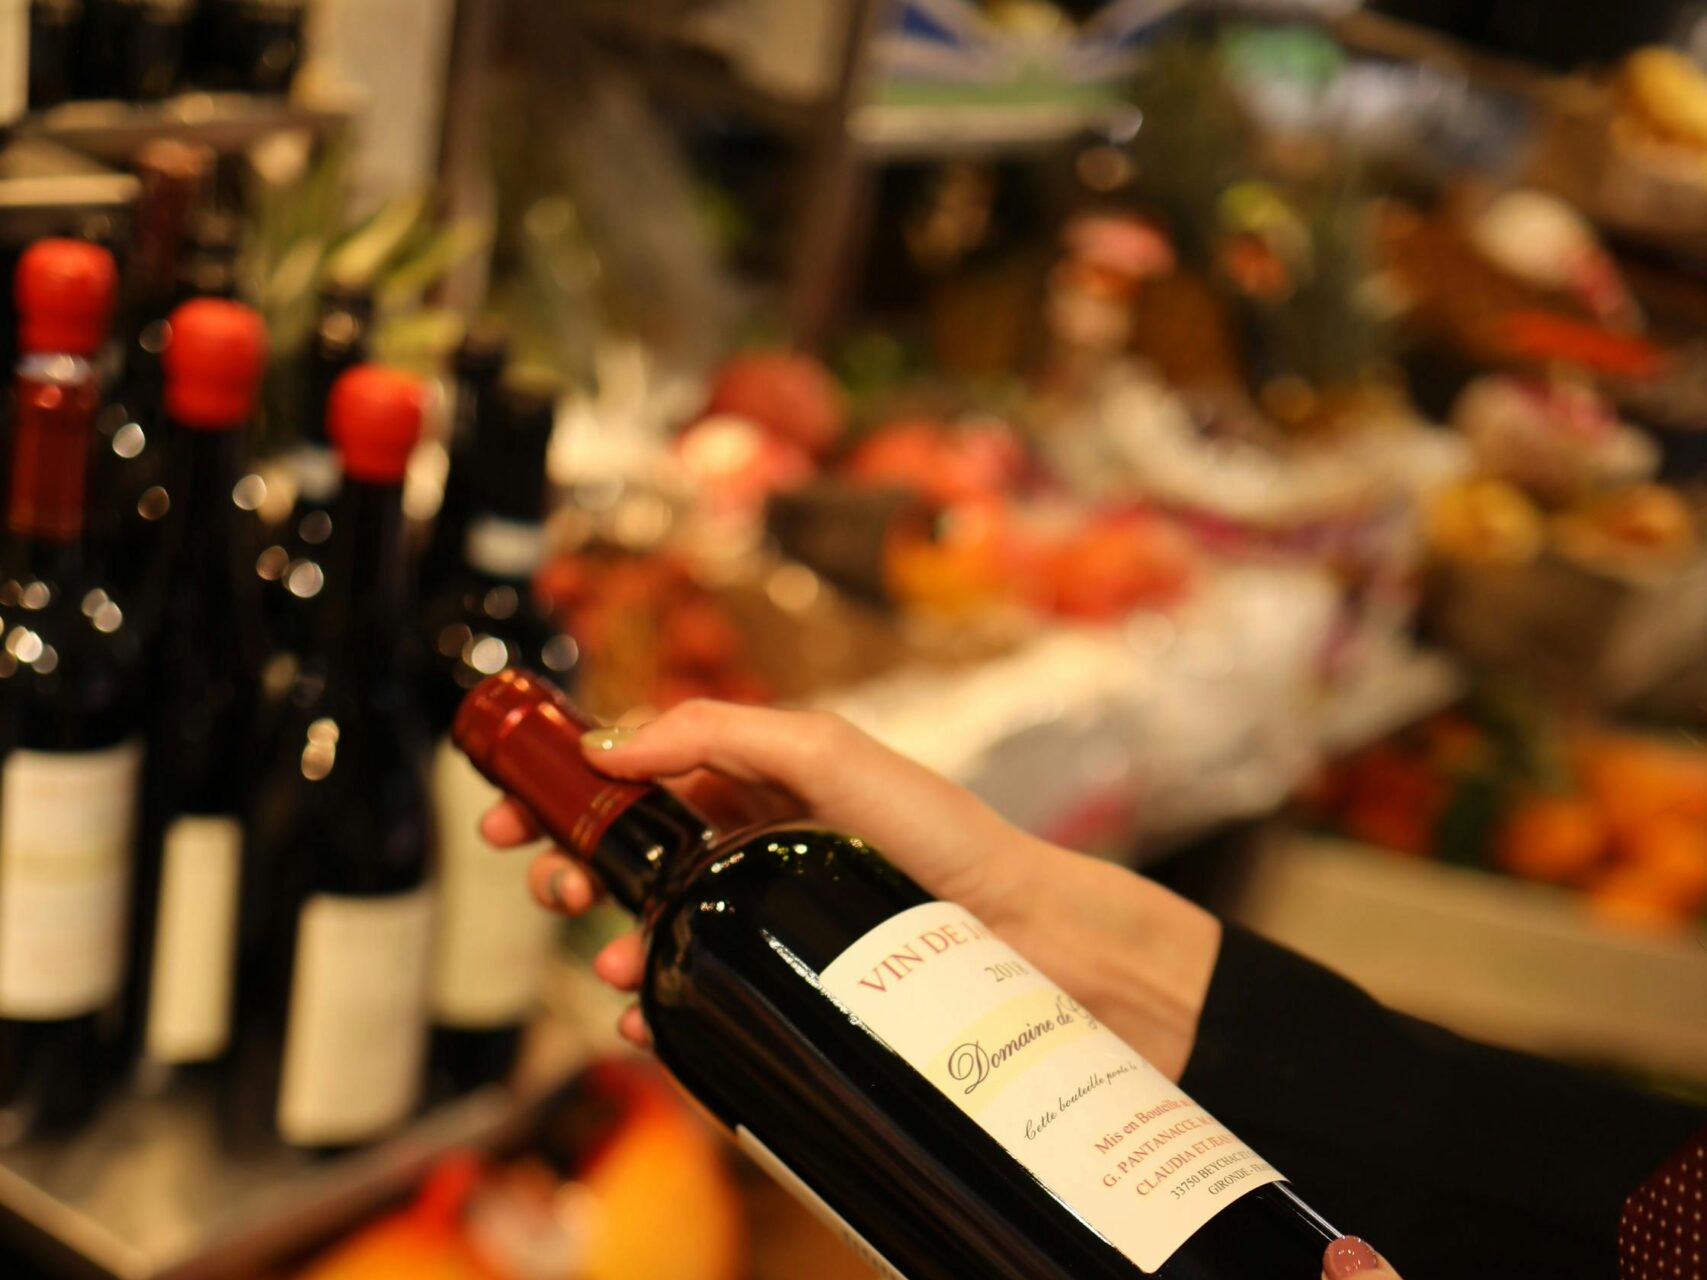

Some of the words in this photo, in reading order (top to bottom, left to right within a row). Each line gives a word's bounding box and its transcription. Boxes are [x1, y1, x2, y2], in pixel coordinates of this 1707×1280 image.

[857, 944, 925, 993] VIN
[919, 923, 969, 954] DE
[947, 1019, 1055, 1095] Domaine
[1056, 995, 1075, 1026] de
[1024, 1111, 1057, 1140] Cette
[1058, 1073, 1105, 1112] bouteille
[1094, 1132, 1125, 1154] Mis
[1122, 1120, 1140, 1134] en
[1102, 1173, 1121, 1187] G.
[1136, 1150, 1197, 1196] CLAUDIA
[1191, 1140, 1210, 1154] ET
[1170, 1174, 1201, 1200] 33750
[1208, 1167, 1252, 1195] GIRONDE
